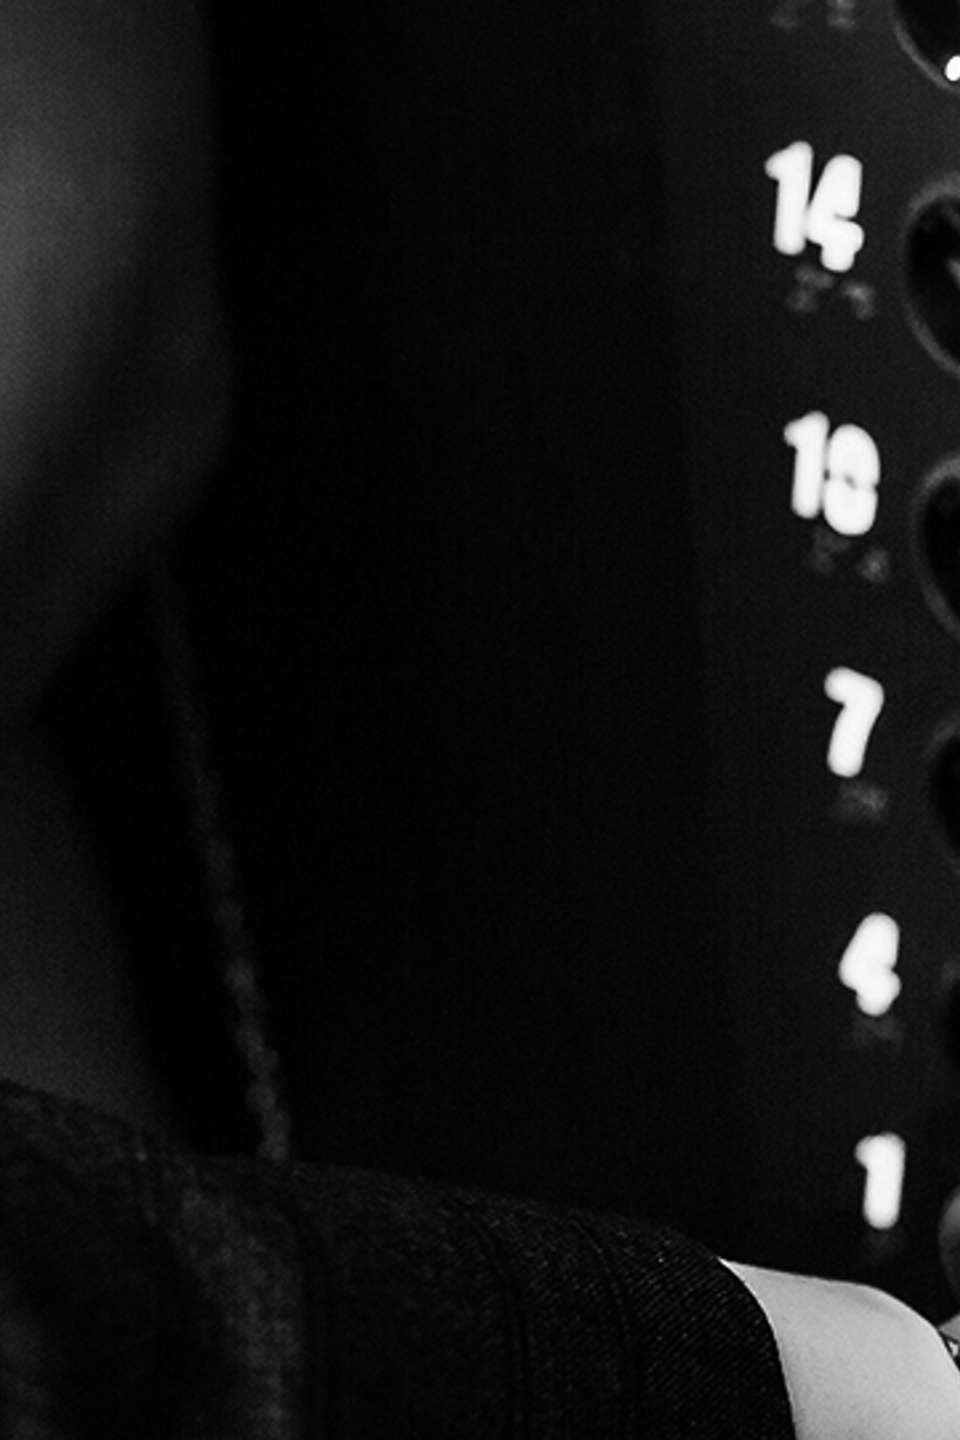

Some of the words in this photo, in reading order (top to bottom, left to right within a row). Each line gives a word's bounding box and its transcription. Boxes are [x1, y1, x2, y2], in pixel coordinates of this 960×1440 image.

[764, 140, 866, 273] 14
[824, 667, 886, 779] 7
[838, 912, 902, 1017] 4
[856, 1134, 906, 1229] 1
